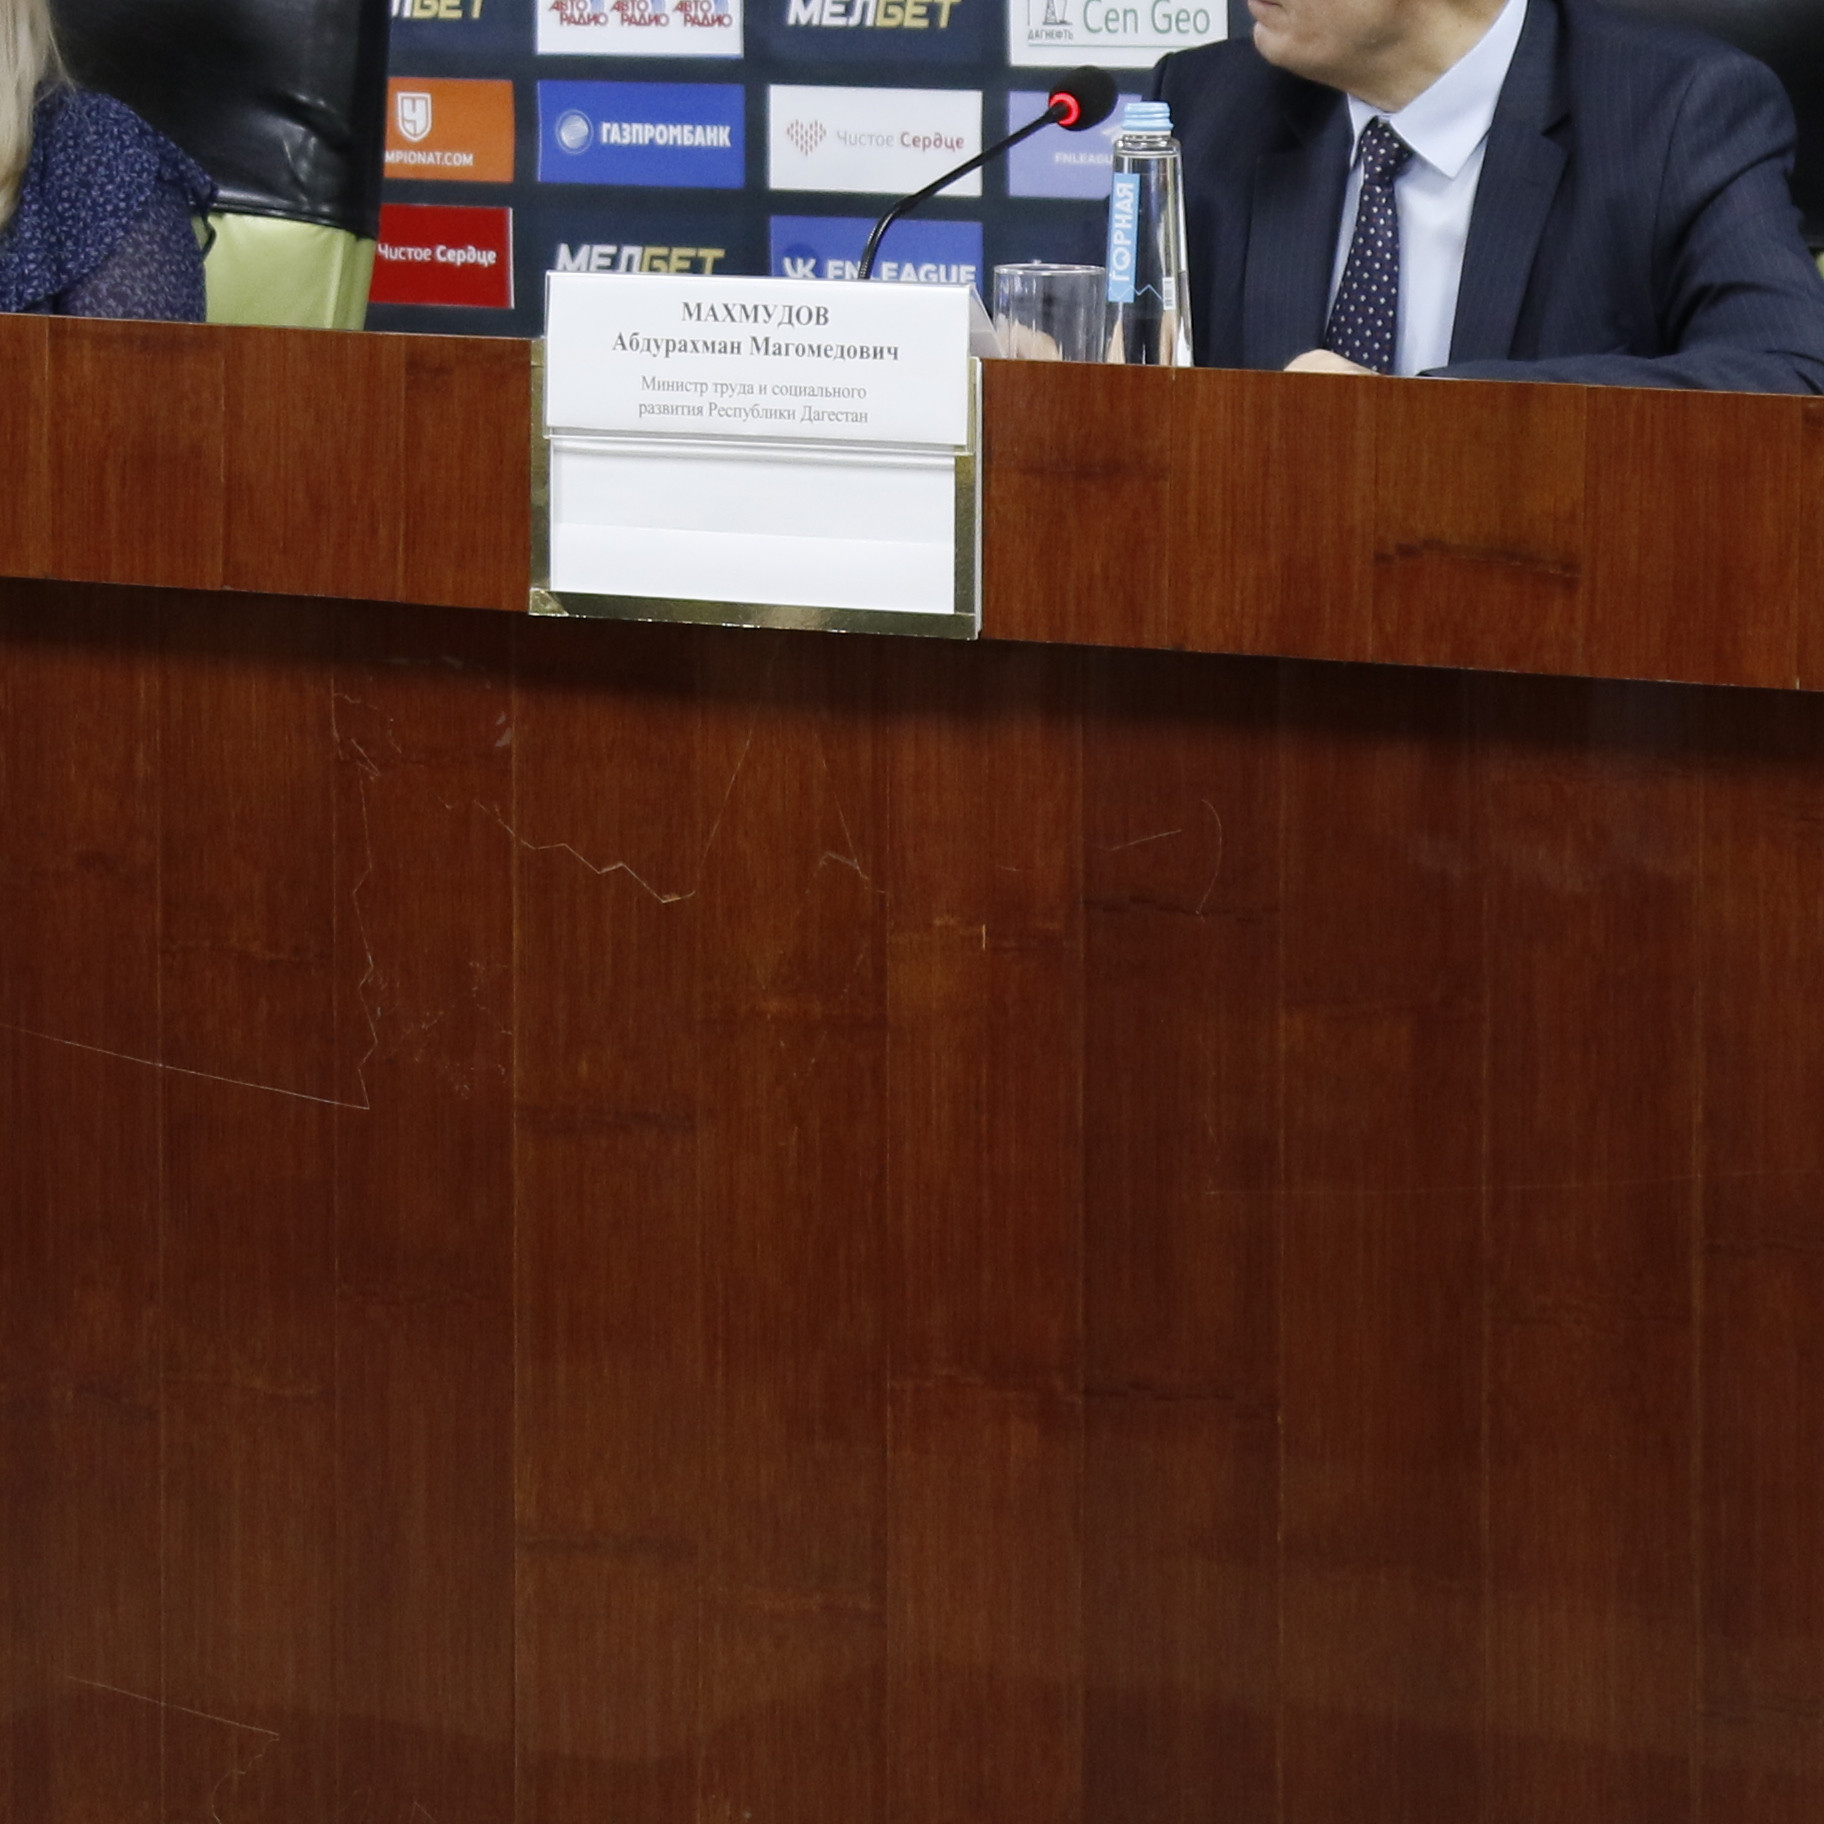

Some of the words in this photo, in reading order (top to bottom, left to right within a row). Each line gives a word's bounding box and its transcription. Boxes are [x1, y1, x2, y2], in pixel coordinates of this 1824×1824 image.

[610, 0, 649, 12] АВТО
[673, 0, 711, 13] АВТО
[560, 12, 608, 26] РАДИО
[620, 13, 669, 27] РАДИО
[684, 14, 732, 27] РАДИО
[600, 122, 730, 147] ГАЗПРОМБАНК
[900, 132, 965, 153] Сердце
[385, 151, 473, 166] MPIONAT.COM
[1110, 183, 1134, 282] ГОРНАЯ
[378, 243, 431, 261] Чистое
[436, 244, 496, 264] Сердце
[555, 243, 724, 273] МЕЛБЕТ
[827, 259, 976, 284] FNEAGUE
[682, 302, 829, 327] МАХМУДОВ
[613, 332, 742, 357] Абдурахман
[750, 336, 899, 361] Магомедович
[641, 376, 708, 395] Министр
[713, 382, 754, 396] труда
[758, 383, 767, 394] и
[772, 381, 866, 399] социального
[639, 403, 703, 418] развития
[708, 402, 795, 421] Республики
[800, 405, 868, 424] Дагестан
